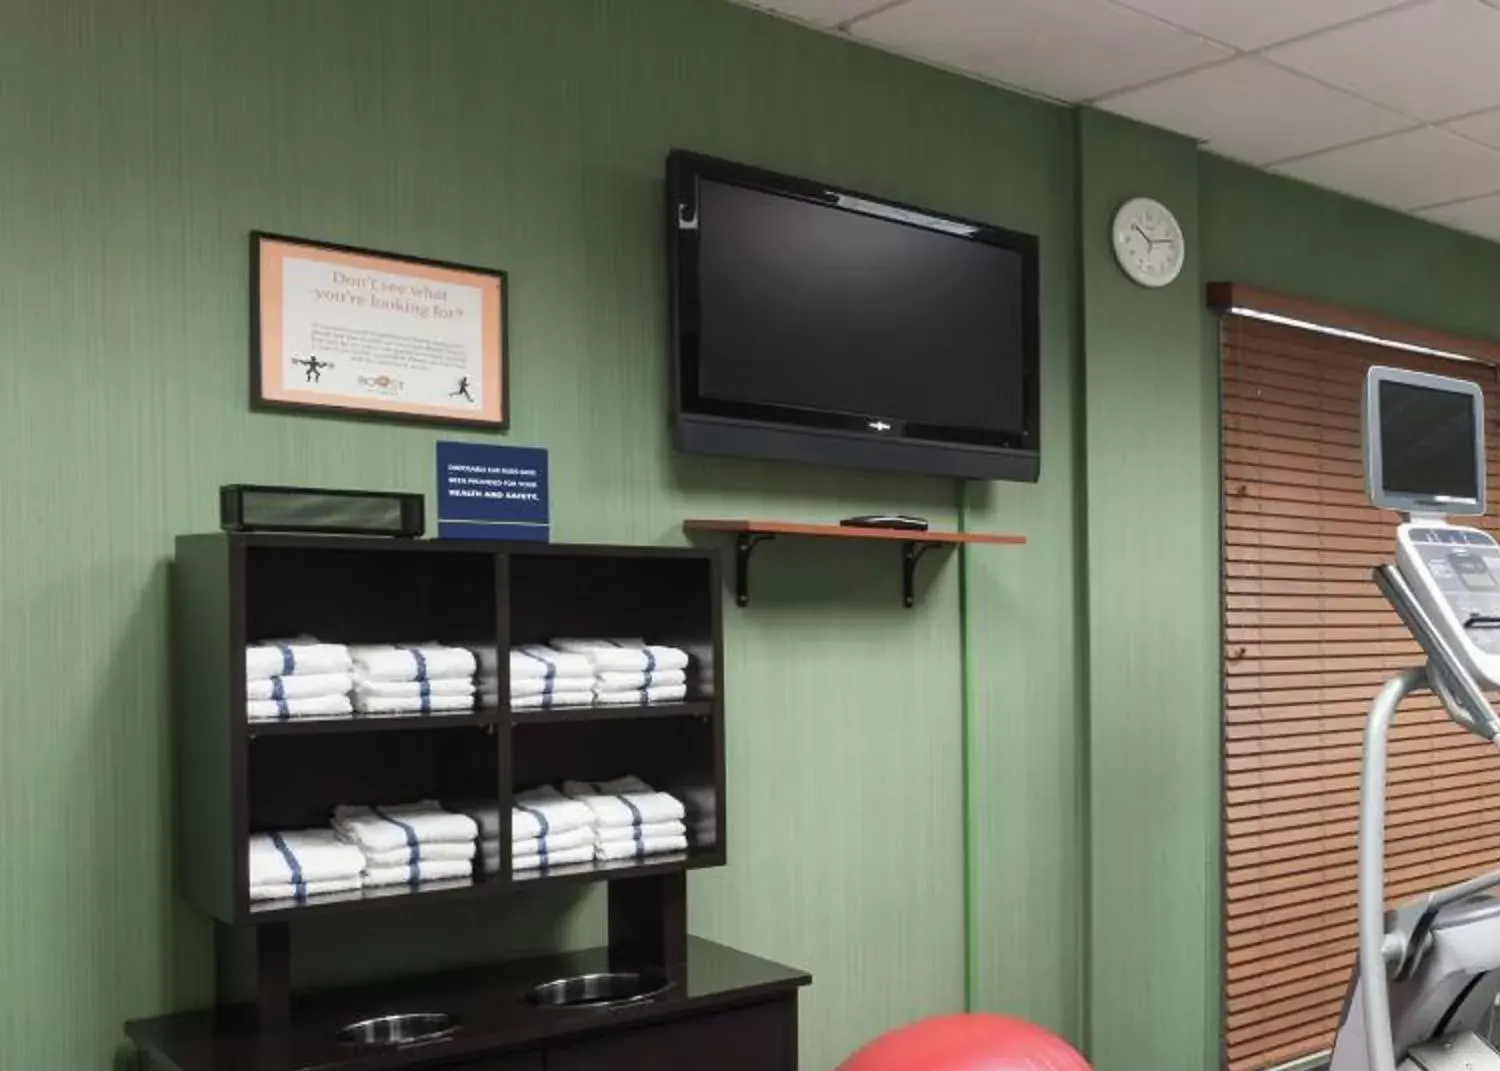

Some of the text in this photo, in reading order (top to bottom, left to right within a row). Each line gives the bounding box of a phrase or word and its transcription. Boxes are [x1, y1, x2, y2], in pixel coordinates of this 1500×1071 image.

[333, 271, 448, 302] Don't see what
[371, 294, 428, 319] looking
